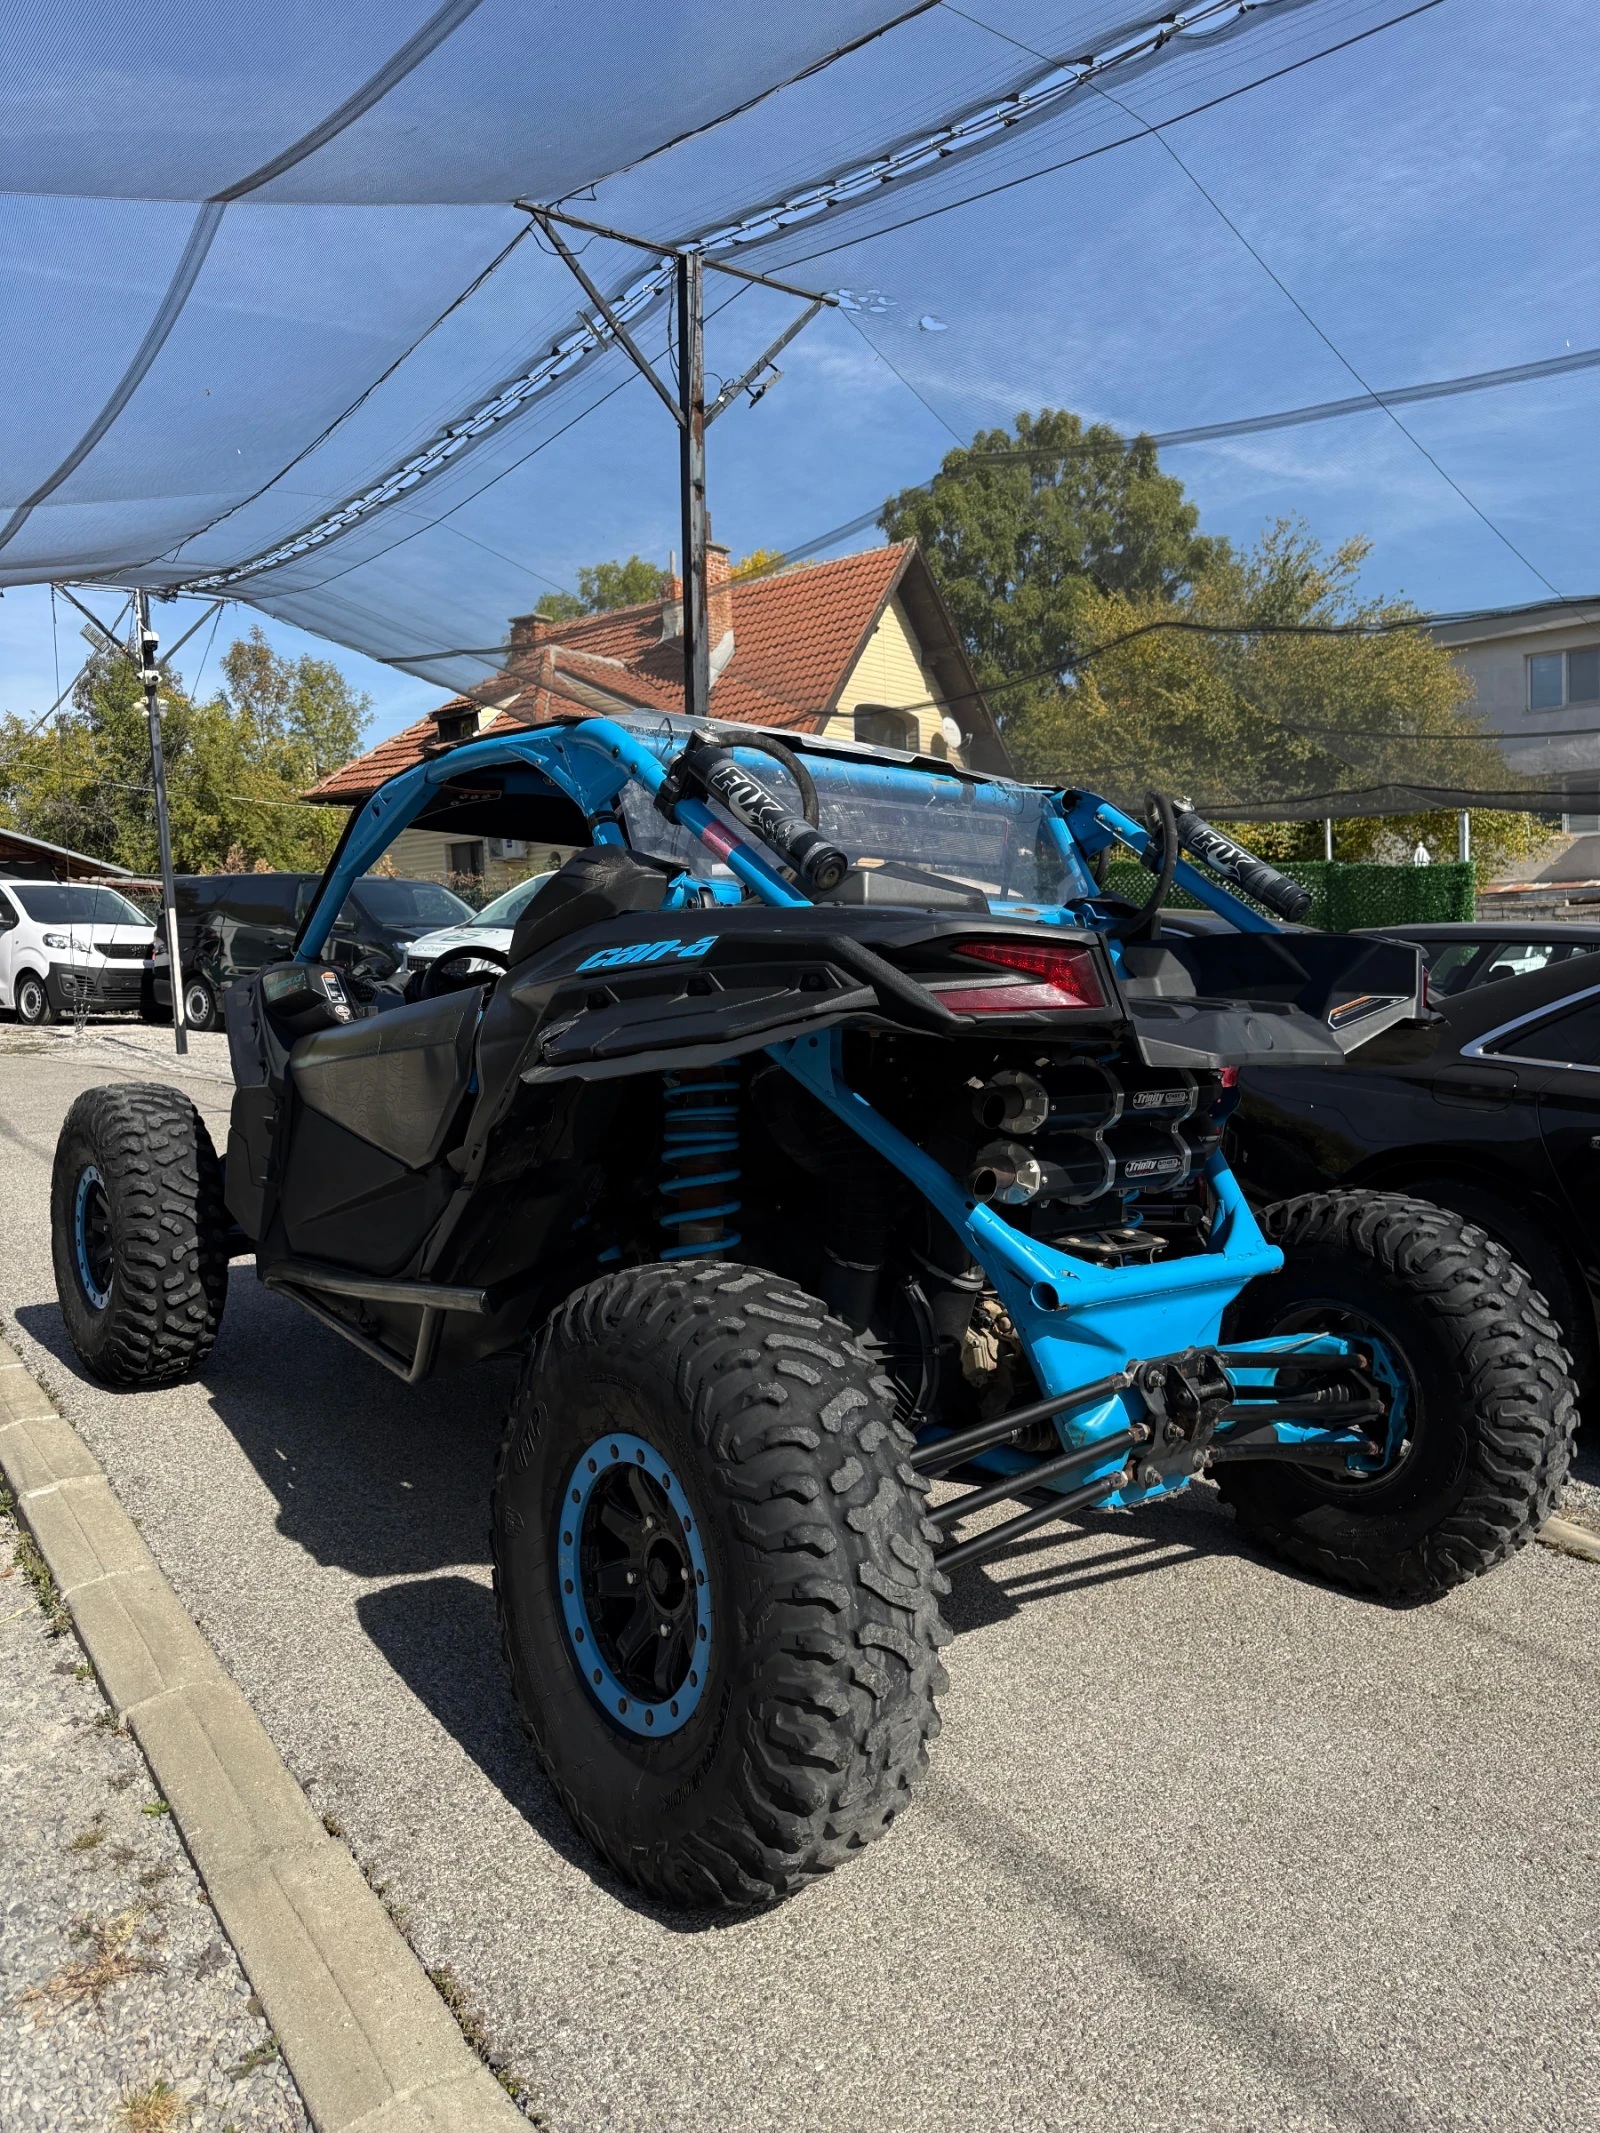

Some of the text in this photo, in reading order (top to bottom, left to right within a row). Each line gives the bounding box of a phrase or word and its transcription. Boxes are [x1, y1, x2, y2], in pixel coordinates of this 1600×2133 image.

[711, 766, 784, 820] FOX
[1190, 829, 1256, 870] FOX
[1136, 1092, 1165, 1104] Trinity
[1129, 1160, 1157, 1172] Trinity
